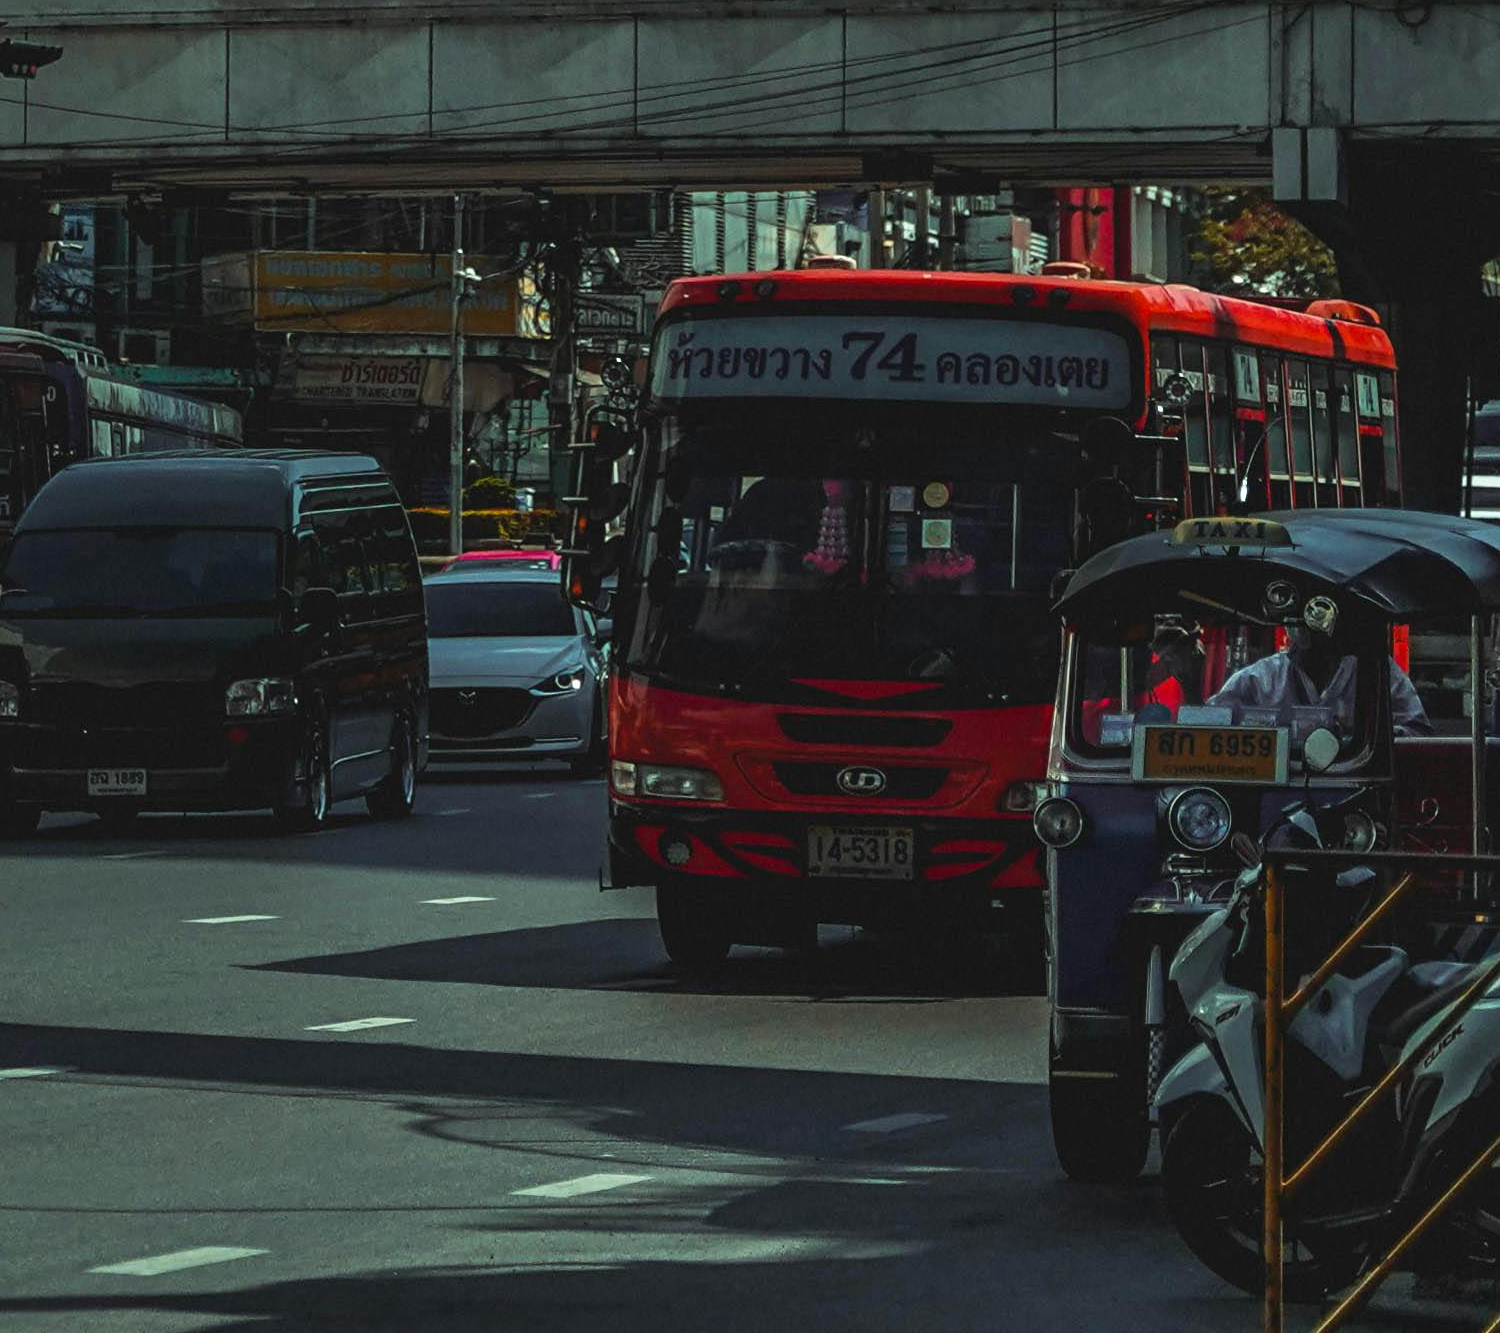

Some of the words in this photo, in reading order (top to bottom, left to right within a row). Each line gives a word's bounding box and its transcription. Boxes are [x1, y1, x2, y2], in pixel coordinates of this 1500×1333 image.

[668, 332, 833, 381] ห้วยขวาง
[841, 331, 927, 382] 74
[936, 351, 1110, 391] คลองเตย
[1194, 520, 1267, 539] TAXI
[1157, 732, 1195, 757] สก
[1209, 734, 1273, 758] 6959
[816, 836, 909, 865] 14-5318
[1423, 1022, 1465, 1069] CLICK
